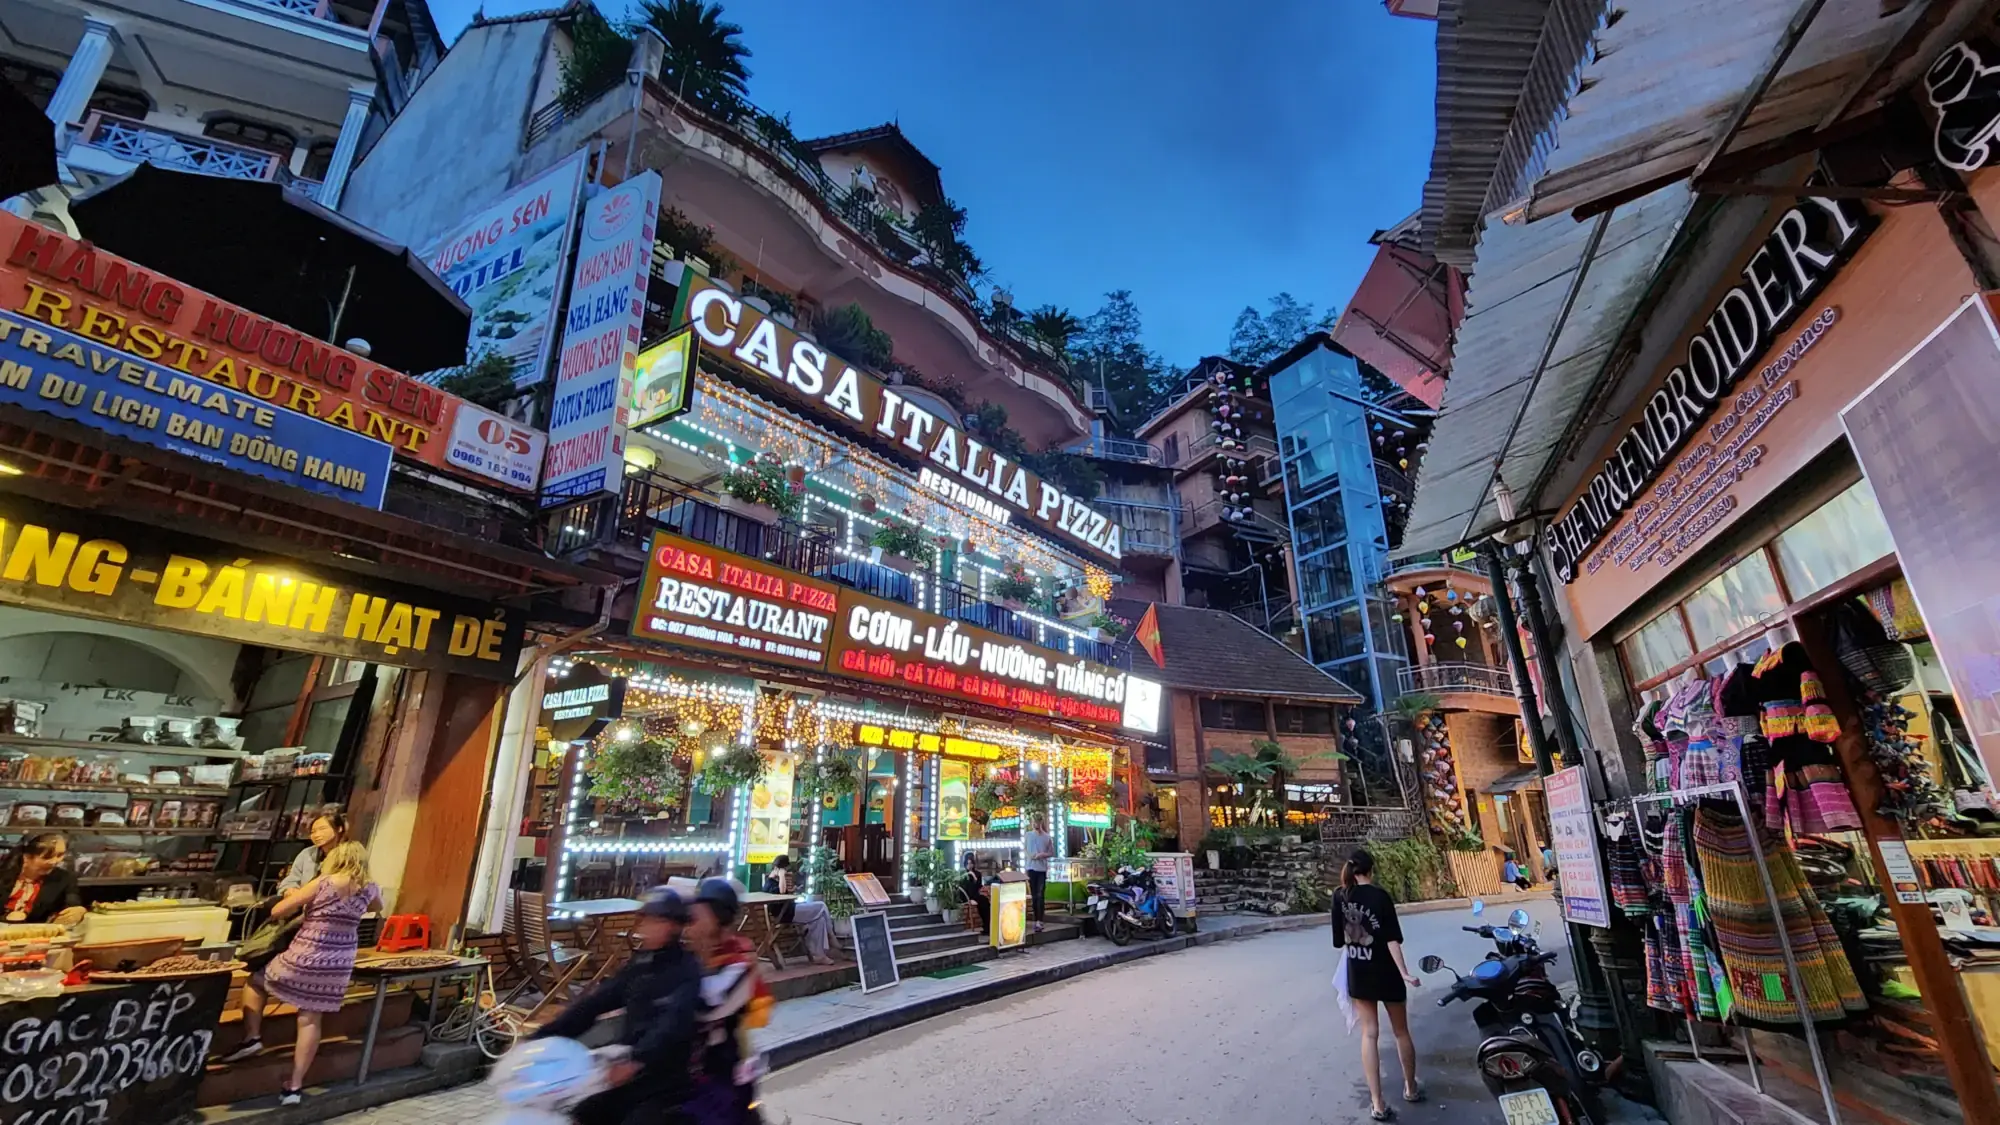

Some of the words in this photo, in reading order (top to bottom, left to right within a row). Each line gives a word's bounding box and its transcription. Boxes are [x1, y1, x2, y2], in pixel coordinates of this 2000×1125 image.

[509, 189, 553, 237] SEN
[450, 245, 529, 299] OTEL
[0, 317, 276, 429] TRAVELMATE
[15, 281, 430, 454] RESTAURANT
[598, 328, 623, 369] SEN
[1760, 306, 1837, 390] Province
[39, 372, 88, 407] DU
[552, 390, 584, 430] LOTUS
[583, 378, 616, 418] HOTEL
[477, 419, 533, 456] 05
[544, 425, 609, 480] RESTAURANT
[688, 287, 864, 422] CASA
[876, 387, 1030, 511] ITALIA
[1035, 479, 1123, 560] PIZZA
[452, 447, 483, 467] 0965
[918, 467, 1012, 526] RESTAURANT
[657, 545, 714, 579] CASA
[721, 562, 785, 599] ITALIA
[790, 581, 838, 613] PIZZA
[343, 592, 441, 655] HẠT
[654, 576, 829, 644] RESTAURANT
[843, 648, 867, 672] CÁ
[903, 662, 925, 685] CÁ
[848, 605, 913, 652] CƠM
[924, 620, 970, 666] LẨU
[979, 640, 1047, 685] NƯỚNG
[543, 690, 563, 710] CASA
[3, 998, 98, 1055] GÁC
[104, 979, 196, 1041] BẾP
[1, 1029, 214, 1103] 0822236607
